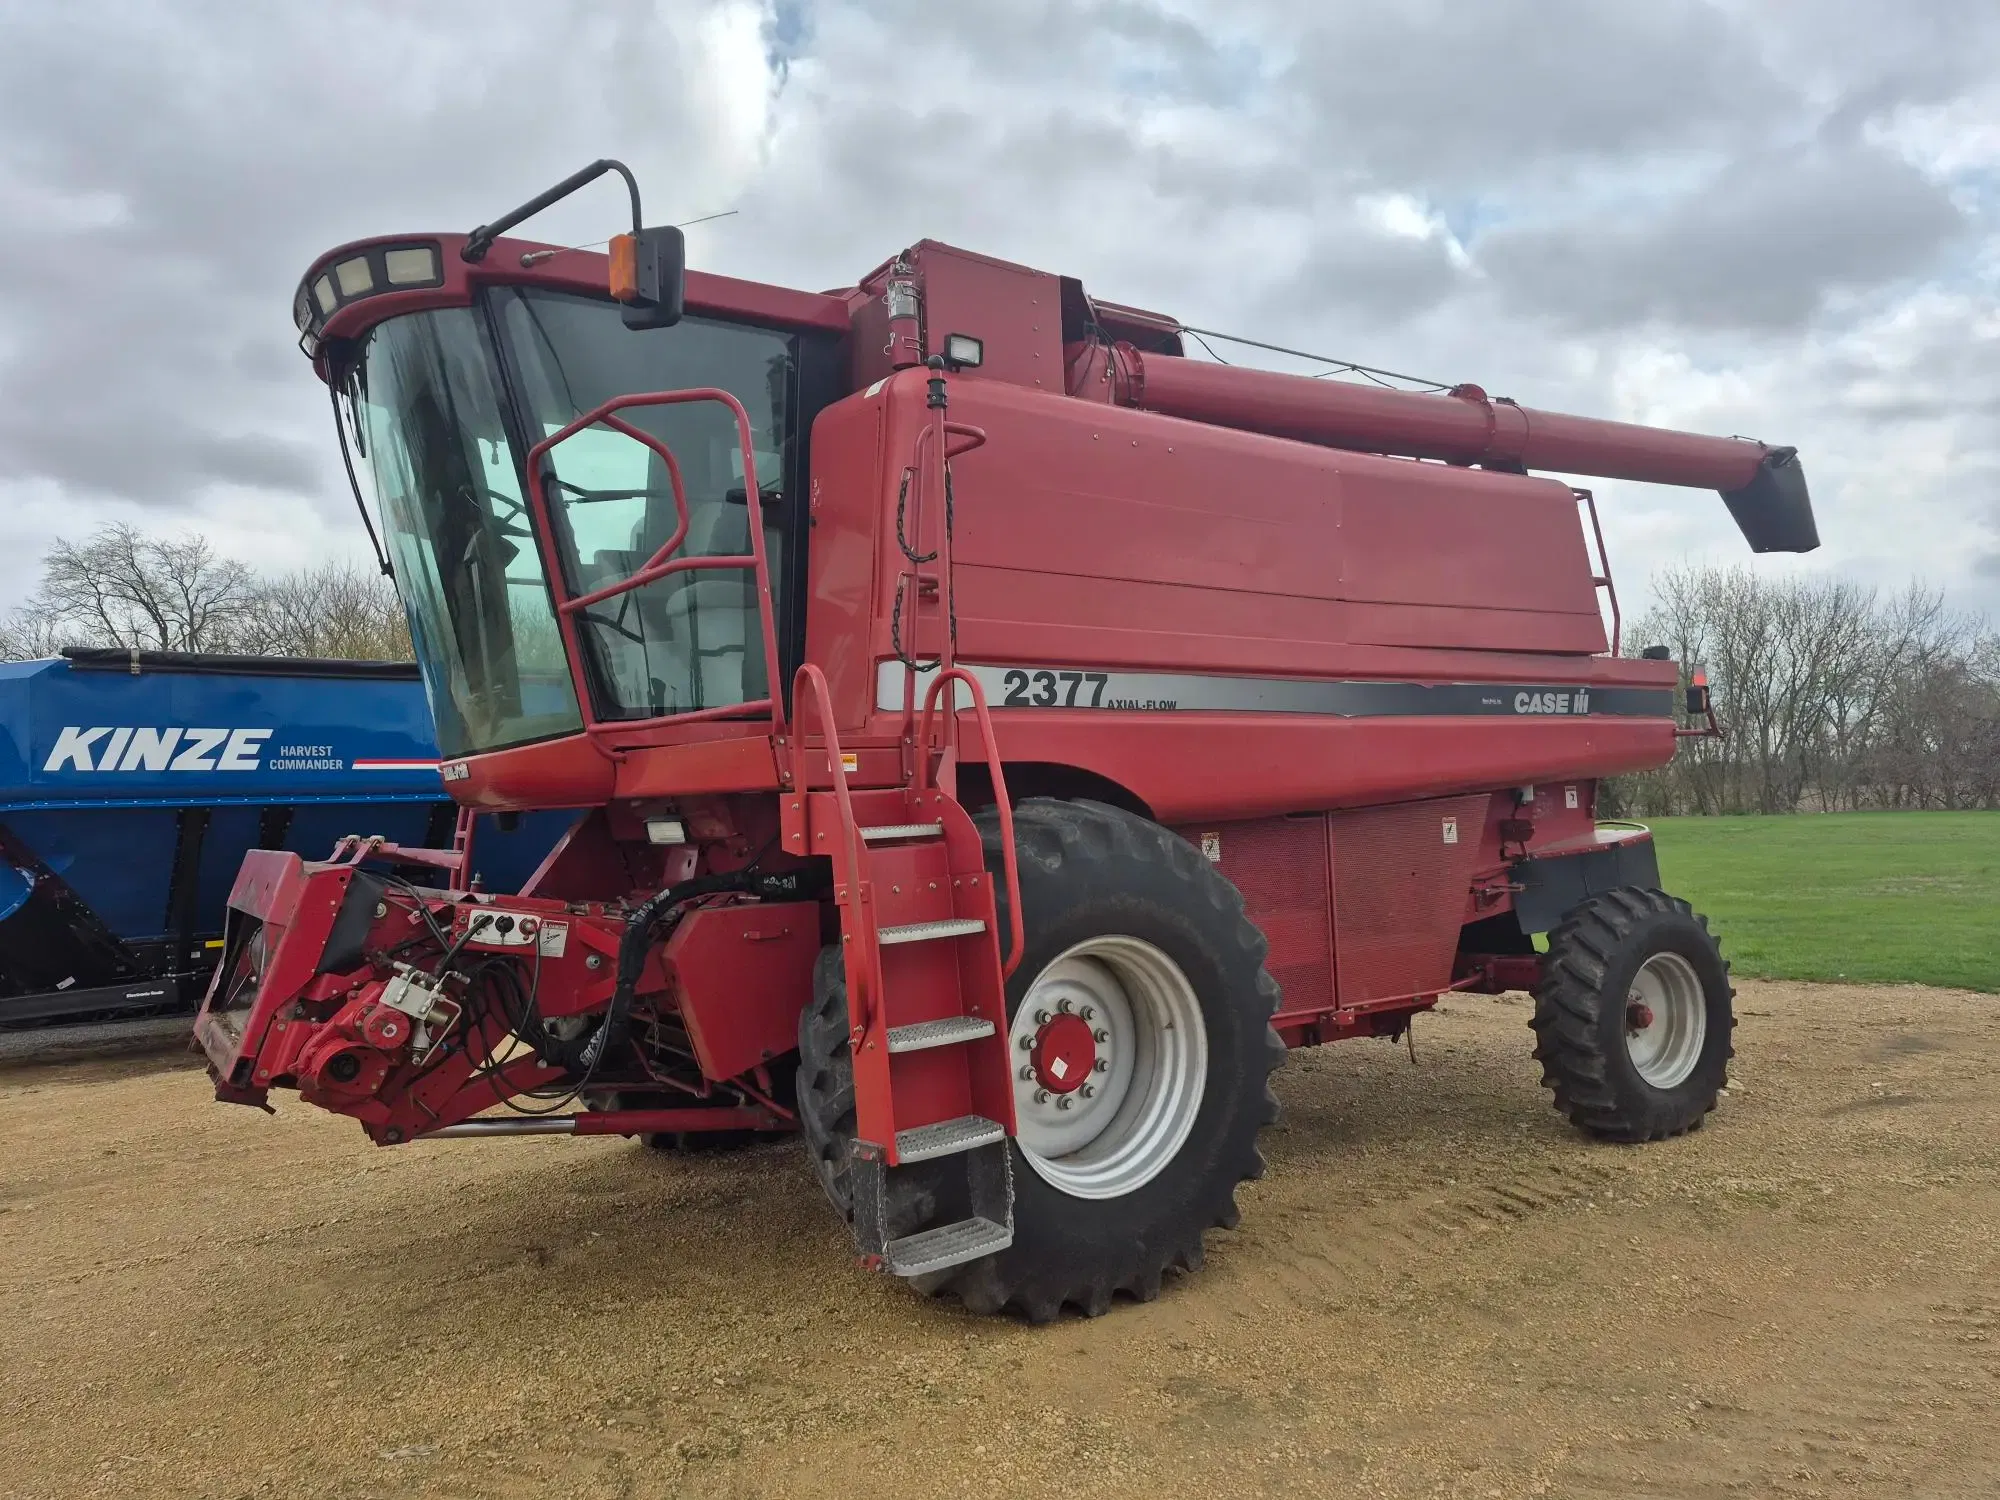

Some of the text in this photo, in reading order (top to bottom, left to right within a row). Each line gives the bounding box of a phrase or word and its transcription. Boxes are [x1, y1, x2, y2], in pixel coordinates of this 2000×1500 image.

[1003, 669, 1108, 707] 2377
[1107, 699, 1177, 711] AXIAL-FLOW
[1514, 692, 1570, 714] CASE
[42, 726, 274, 772] KINZE
[280, 745, 333, 757] HARVEST
[269, 759, 343, 771] COMMANDER
